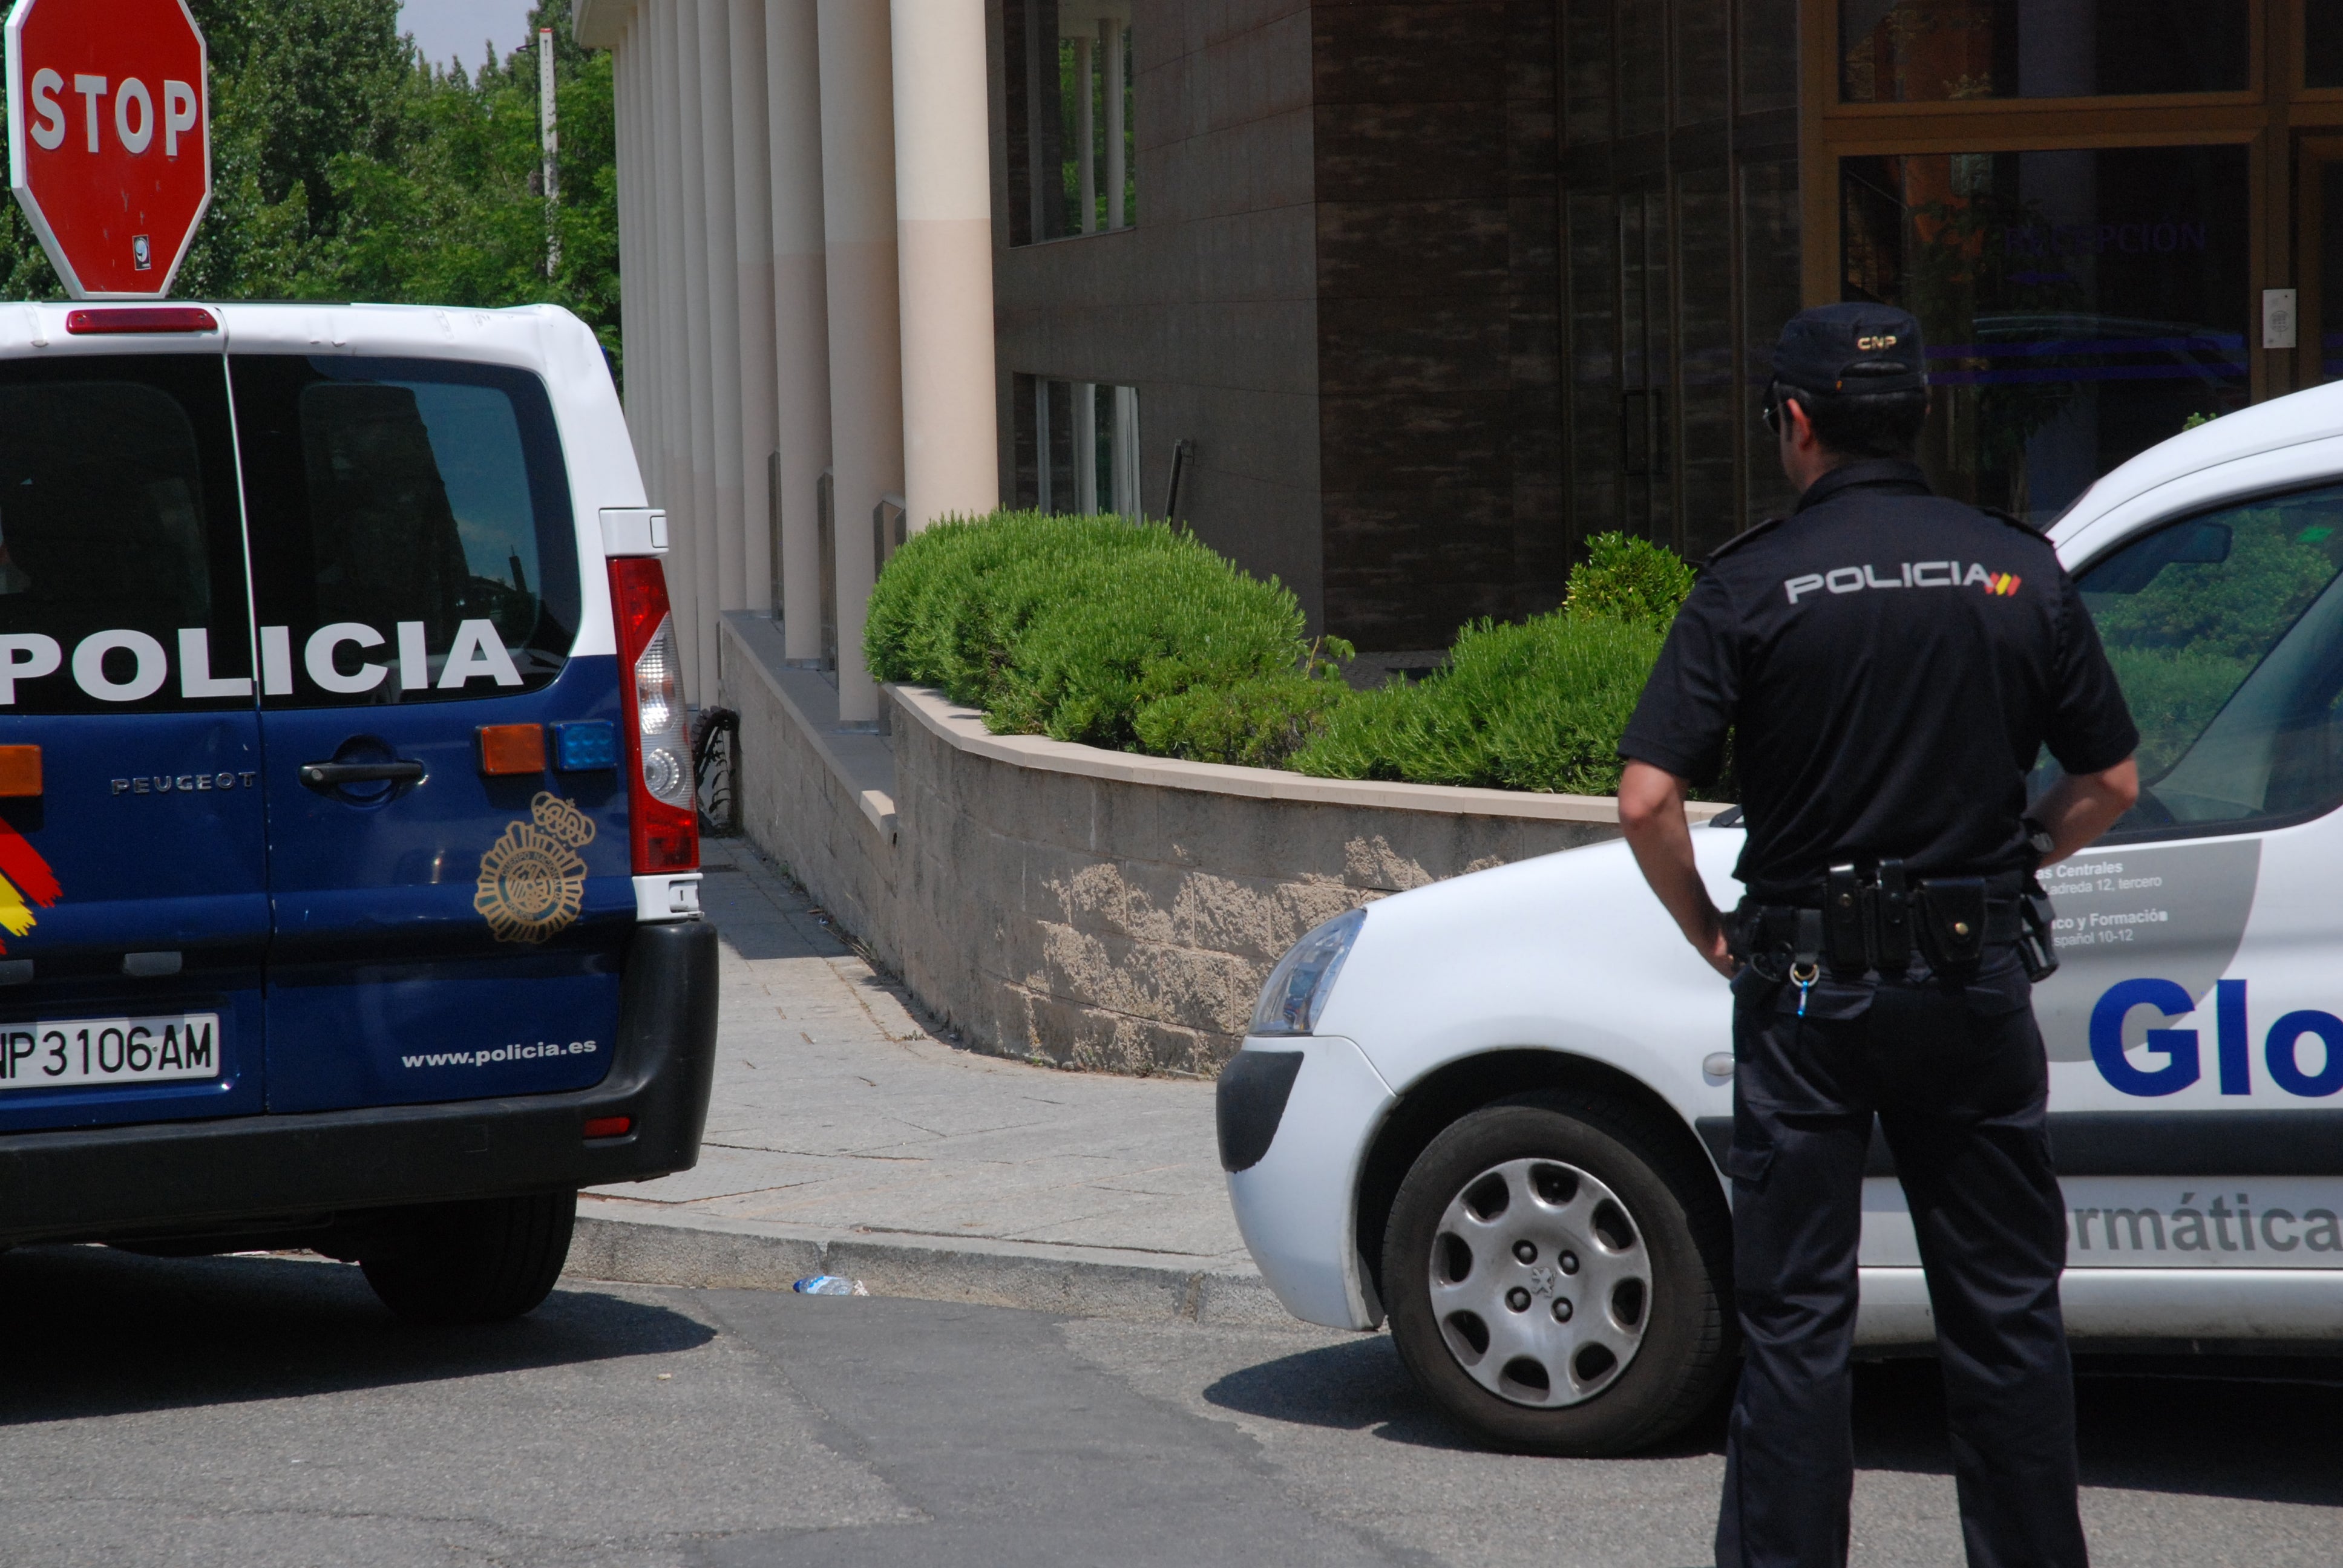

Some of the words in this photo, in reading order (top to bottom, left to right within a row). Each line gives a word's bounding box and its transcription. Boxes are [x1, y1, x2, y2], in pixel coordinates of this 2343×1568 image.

[30, 68, 197, 157] STOP
[1857, 336, 1896, 350] CNP
[1784, 561, 1993, 604] POLICIA
[0, 619, 524, 705] POLICIA
[111, 771, 257, 795] PEUGEOT
[502, 851, 530, 877] CUERPO
[534, 851, 563, 892] NACIONAL
[2057, 861, 2124, 877] Centrales
[2096, 878, 2115, 892] 12,
[2119, 877, 2163, 890] tercero
[2077, 917, 2086, 931] y
[2089, 907, 2168, 927] Formación
[2098, 929, 2134, 943] 10-12
[2089, 978, 2343, 1097] Glo
[401, 1040, 597, 1067] www.policia.es
